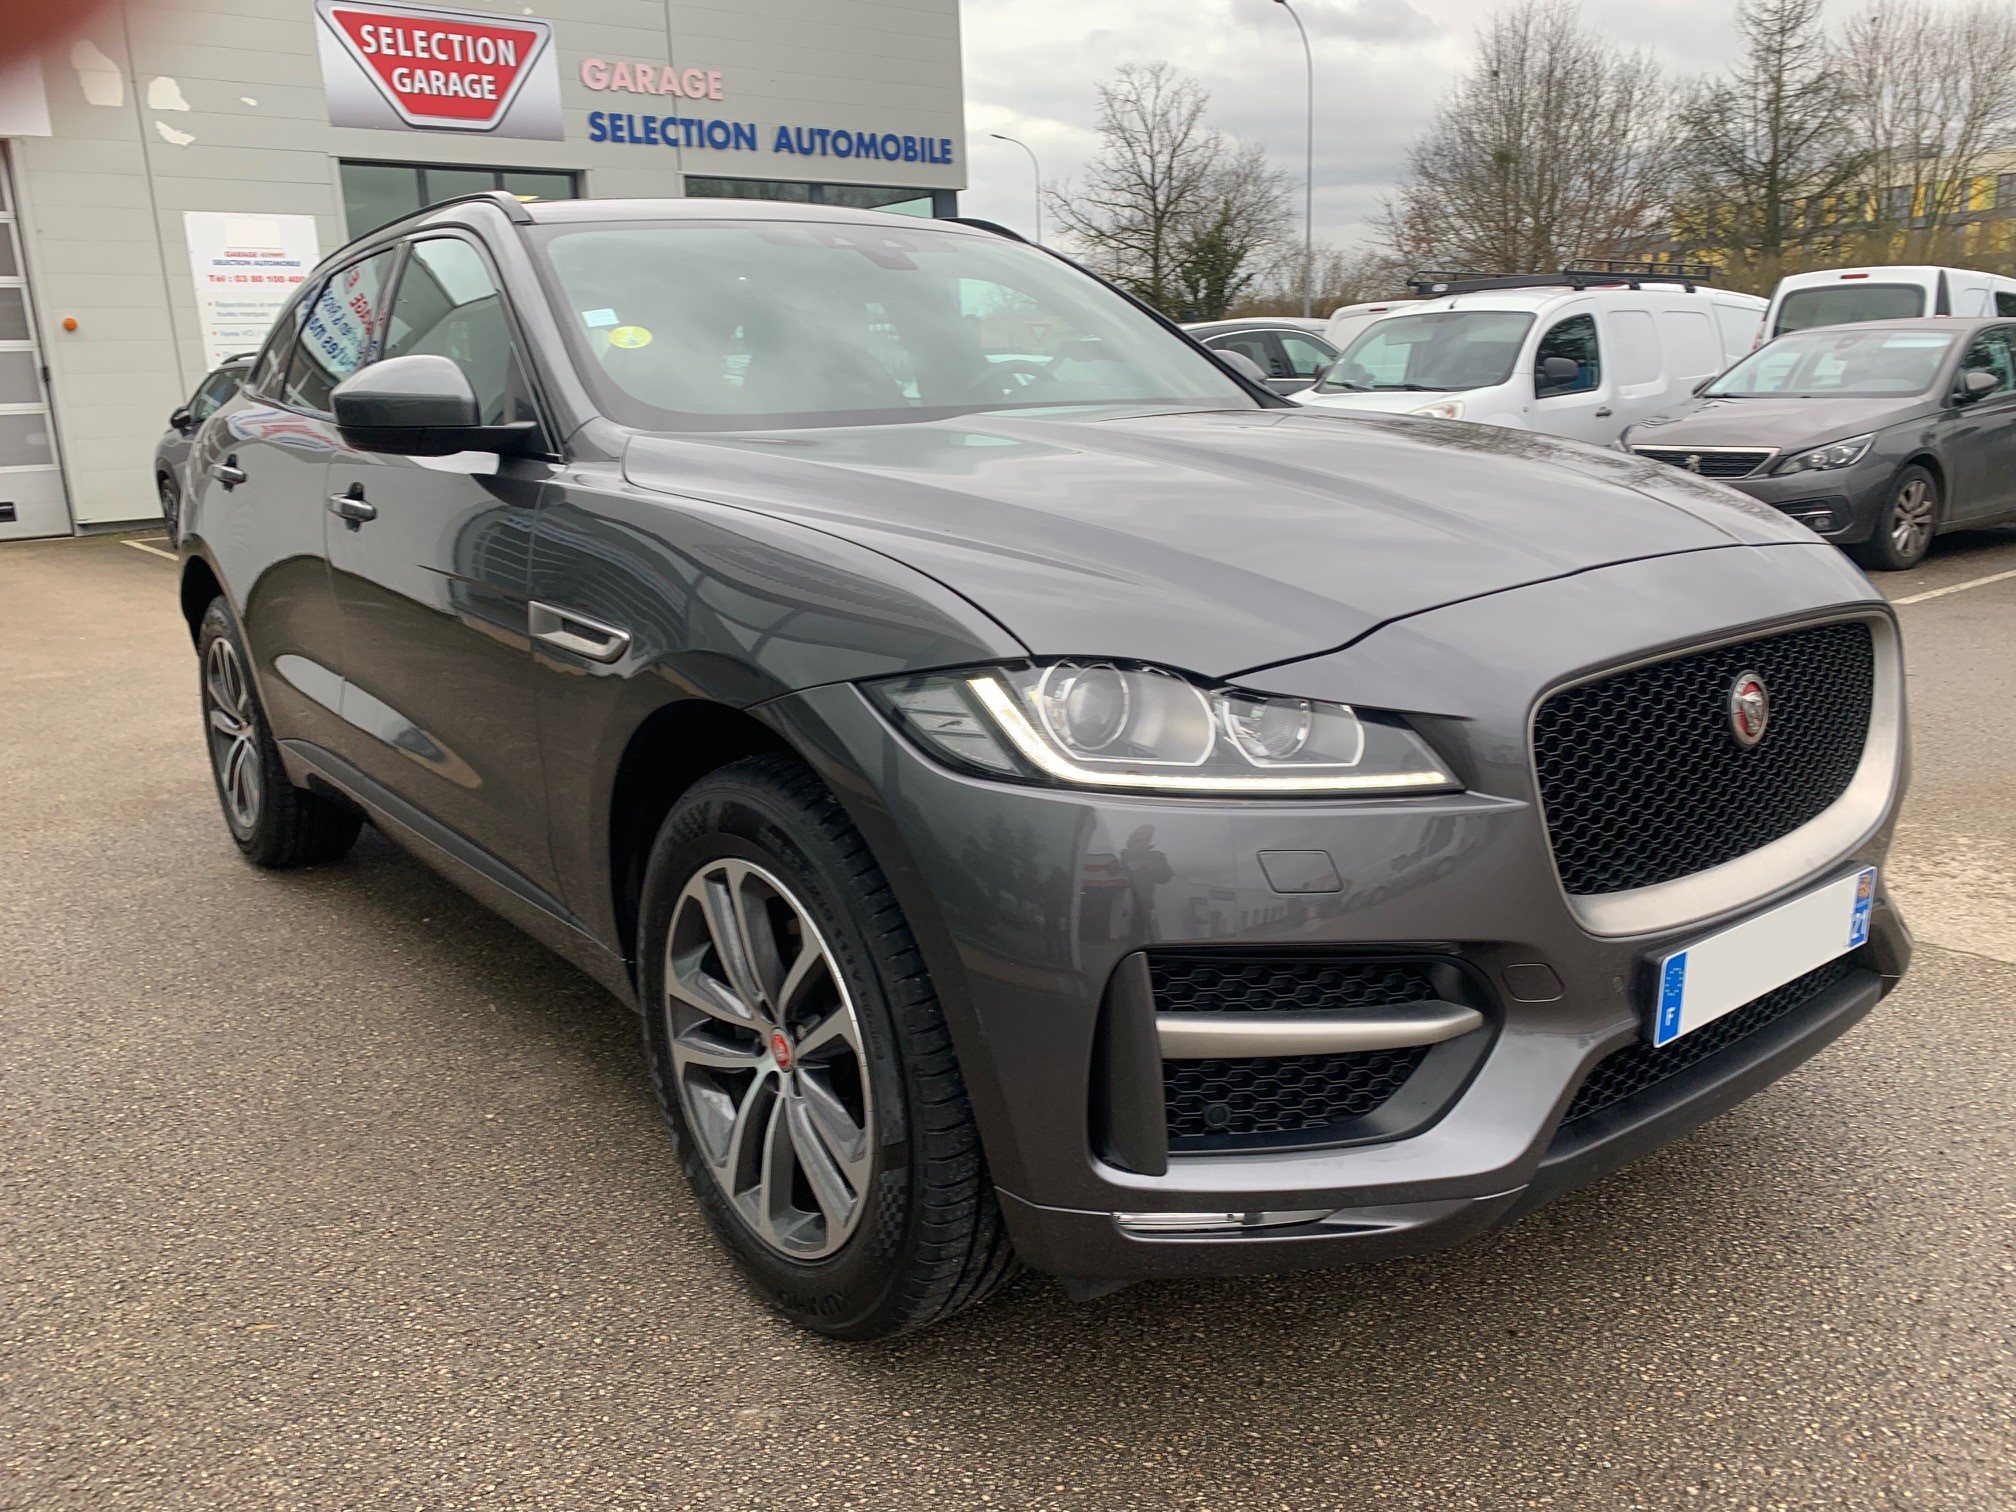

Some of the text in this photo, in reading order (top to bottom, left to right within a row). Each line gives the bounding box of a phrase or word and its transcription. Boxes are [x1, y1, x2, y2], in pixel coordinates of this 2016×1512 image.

[360, 24, 517, 67] SELECTION
[391, 66, 498, 100] GARAGE
[581, 58, 724, 101] GARAGE
[588, 111, 953, 165] SELECTION AUTOMOBILE
[234, 275, 248, 283] 03
[250, 275, 264, 283] 80
[266, 275, 286, 283] 100
[1665, 1006, 1676, 1026] F
